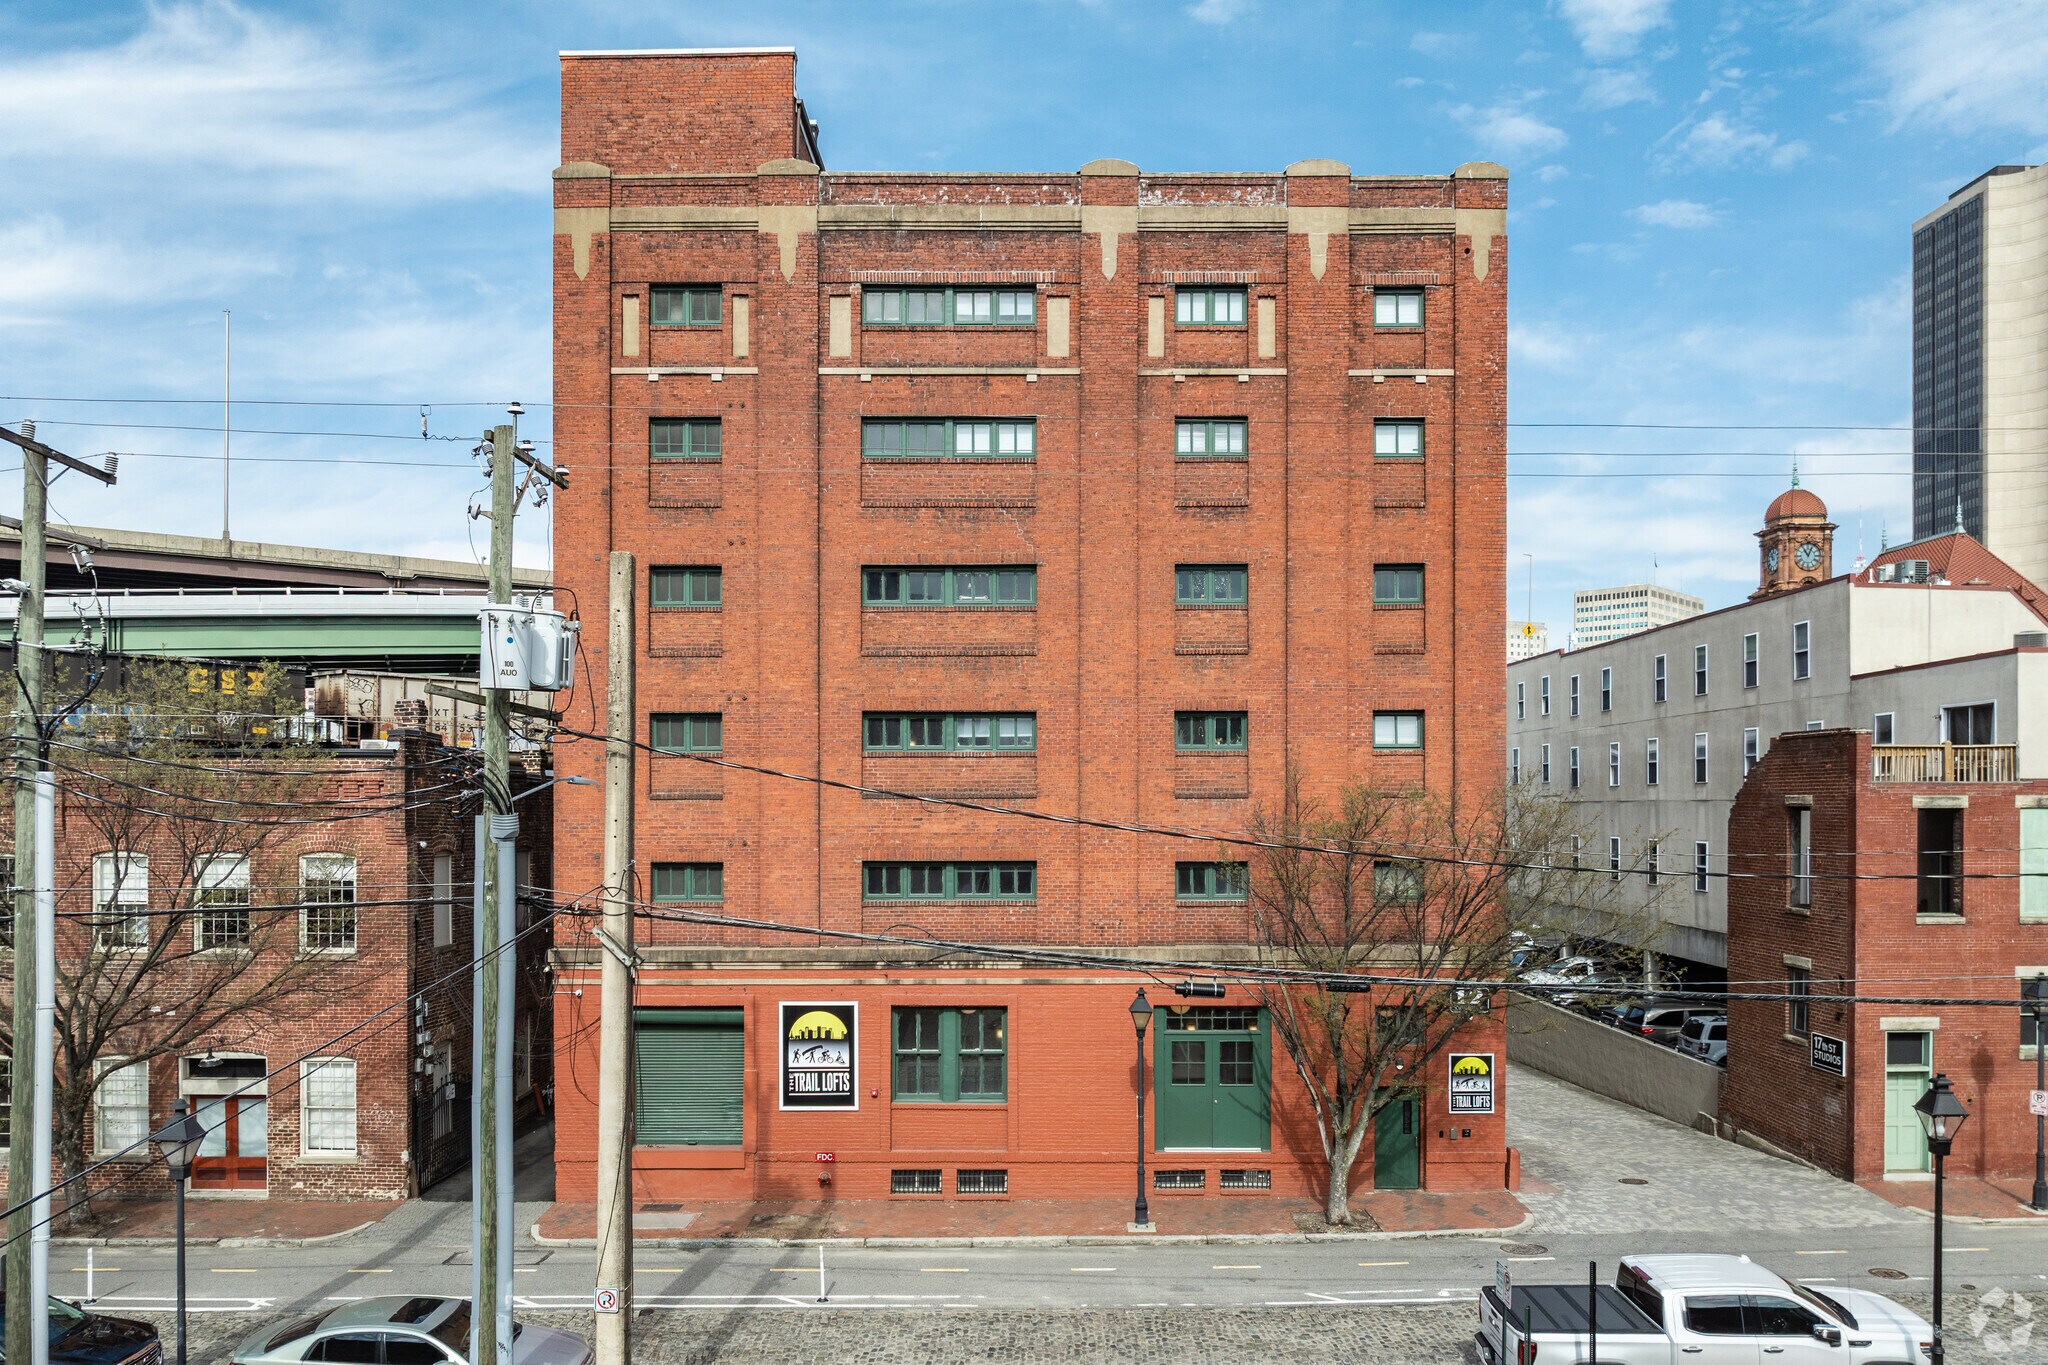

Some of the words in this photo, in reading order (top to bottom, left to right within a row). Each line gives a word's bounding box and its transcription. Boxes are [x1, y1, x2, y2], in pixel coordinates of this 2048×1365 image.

[504, 660, 514, 668] 100
[188, 668, 268, 691] CSX
[1813, 1036, 1828, 1052] 17th
[1828, 1043, 1837, 1054] ST
[1813, 1049, 1842, 1066] STUDIOS
[794, 1072, 820, 1092] TRAIL
[822, 1072, 850, 1092] LOFTS
[1456, 1095, 1472, 1108] TRAIL
[1472, 1095, 1490, 1108] LOFTS
[816, 1153, 833, 1161] FDC
